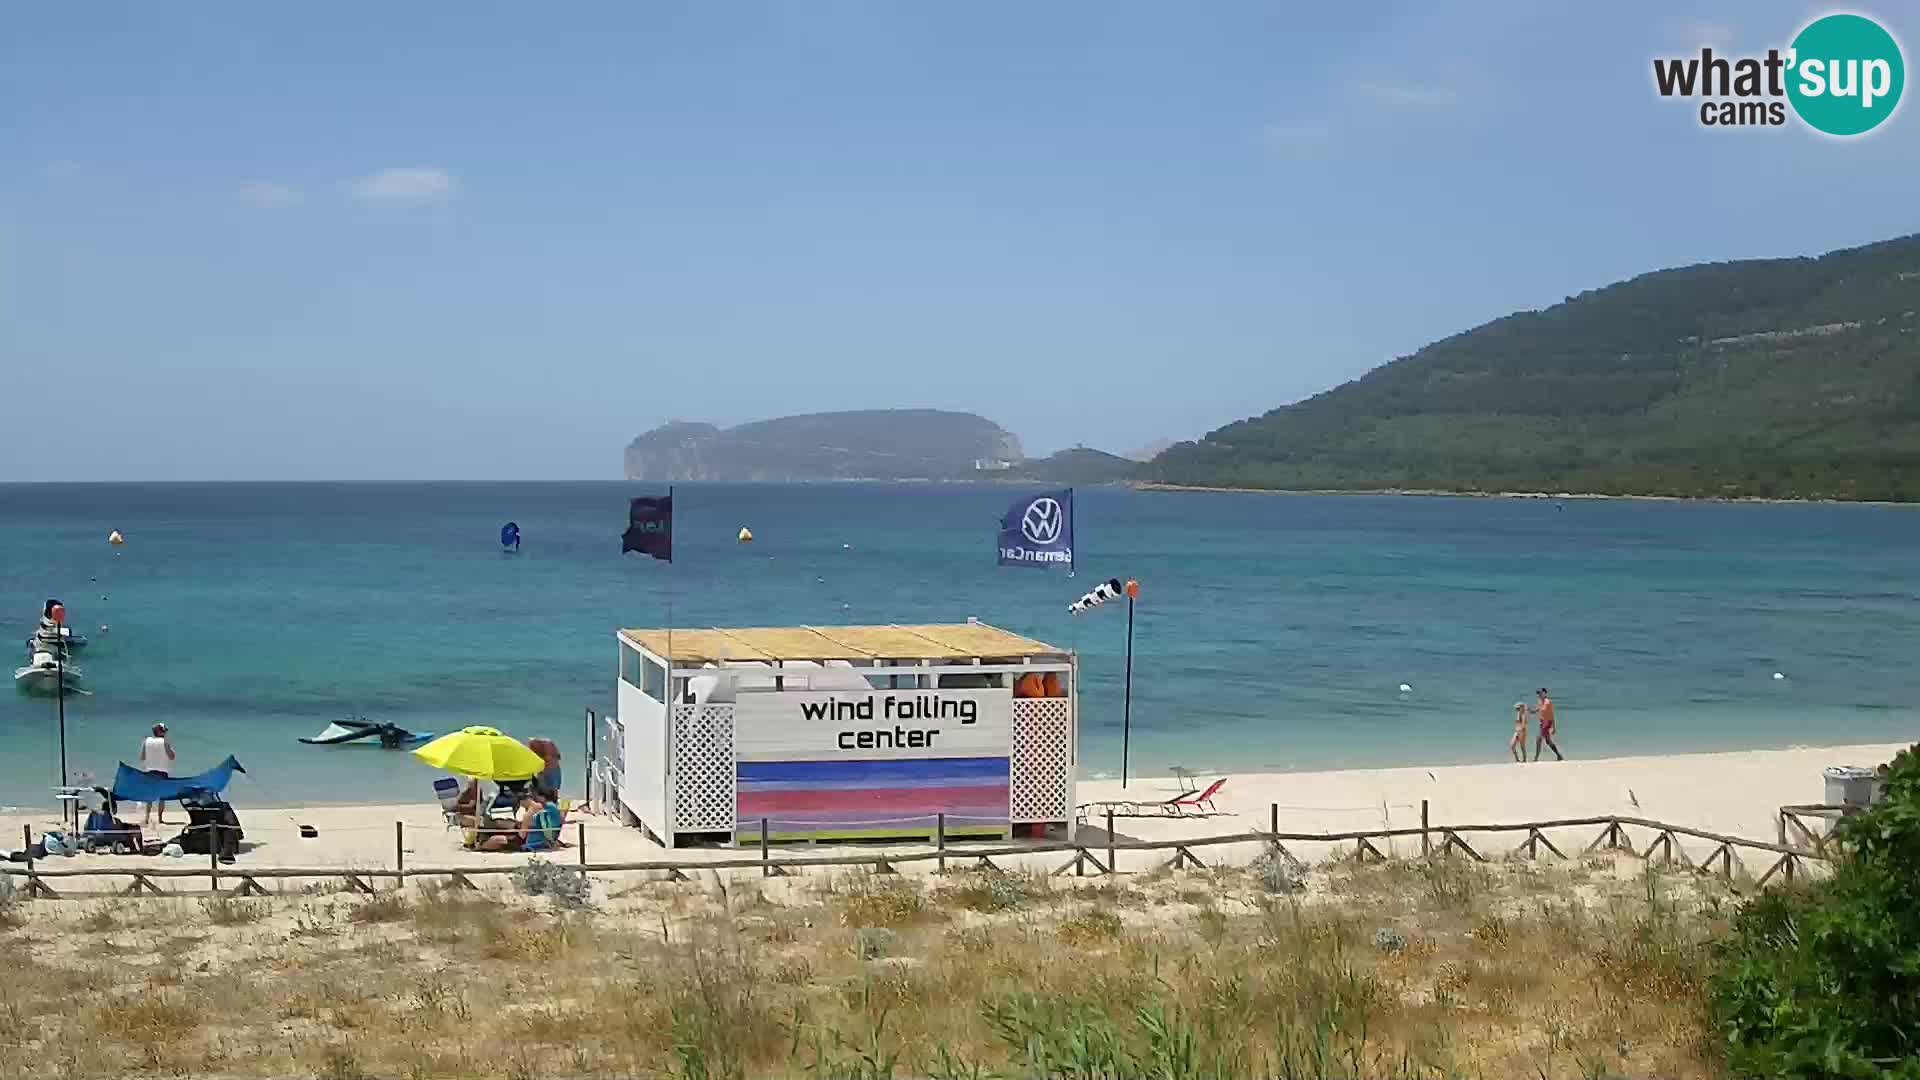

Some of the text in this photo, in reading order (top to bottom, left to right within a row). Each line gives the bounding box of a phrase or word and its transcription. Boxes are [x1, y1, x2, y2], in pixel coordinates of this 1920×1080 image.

[800, 695, 977, 724] wind foiling
[838, 725, 940, 749] center
